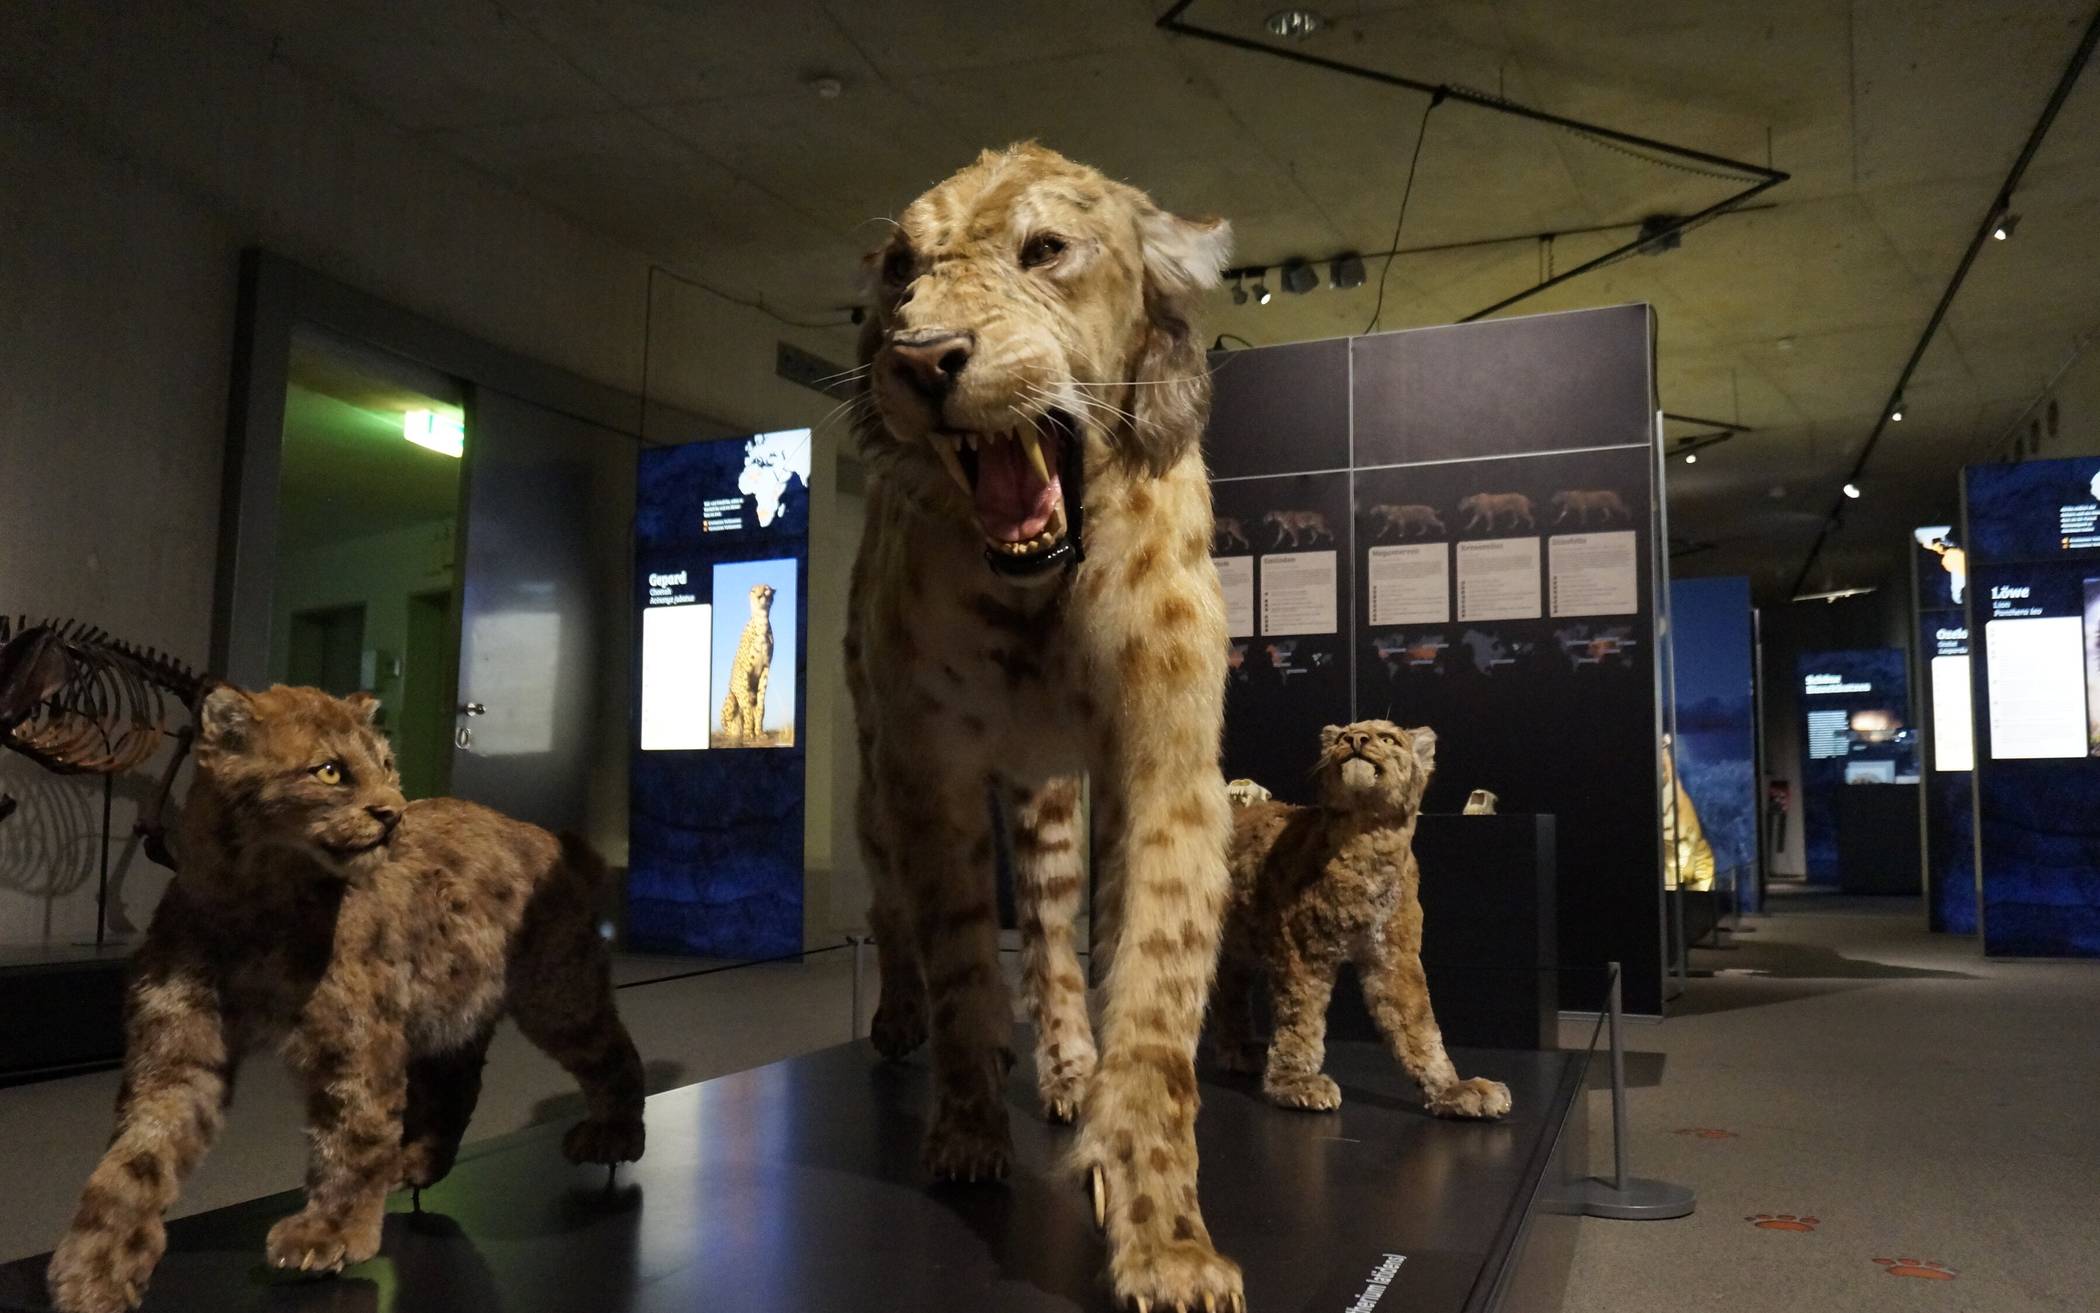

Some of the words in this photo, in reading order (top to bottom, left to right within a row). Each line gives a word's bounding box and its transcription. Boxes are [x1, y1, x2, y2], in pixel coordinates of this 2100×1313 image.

[649, 570, 688, 589] Gepard
[1991, 585, 2030, 599] Löwe
[1936, 627, 1968, 639] Ozelo
